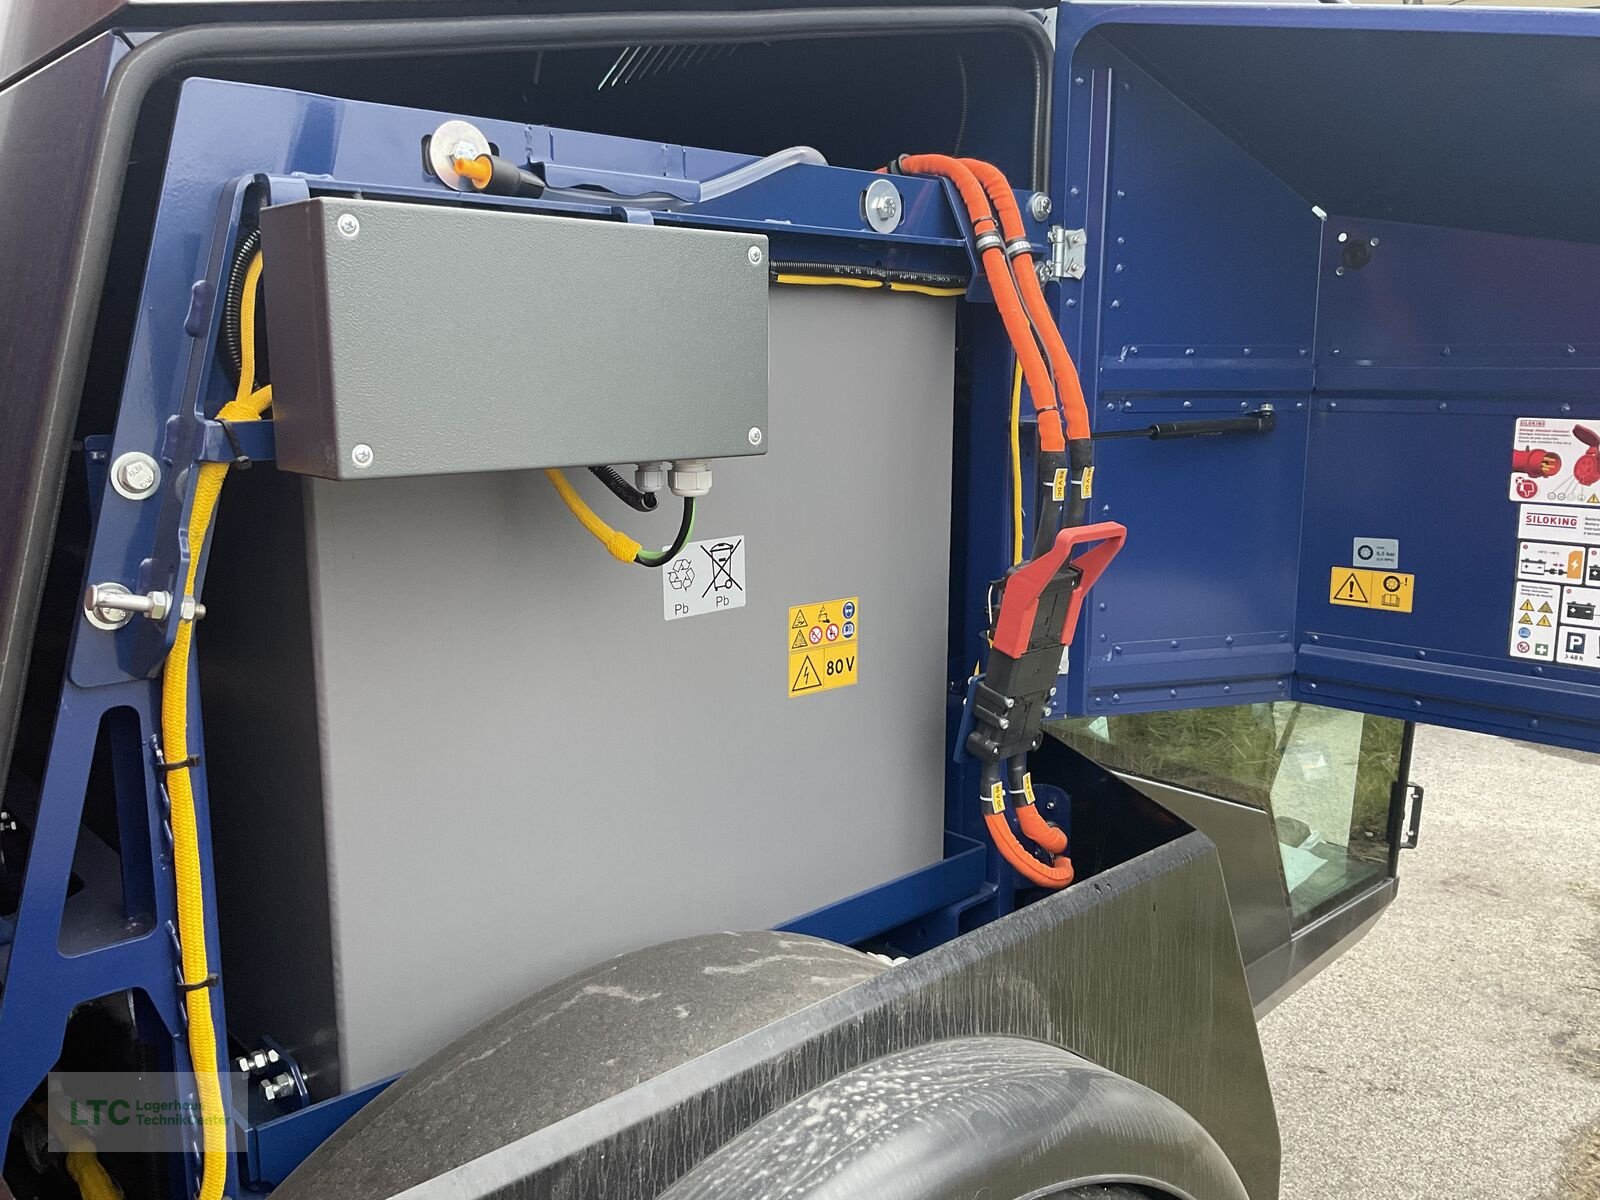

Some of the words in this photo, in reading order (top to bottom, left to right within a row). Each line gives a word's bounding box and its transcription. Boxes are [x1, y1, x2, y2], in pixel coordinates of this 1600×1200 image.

[1526, 515, 1578, 526] SILOKING
[716, 595, 729, 607] Pb
[675, 603, 689, 616] Pb
[826, 660, 843, 676] 80
[846, 656, 854, 672] V
